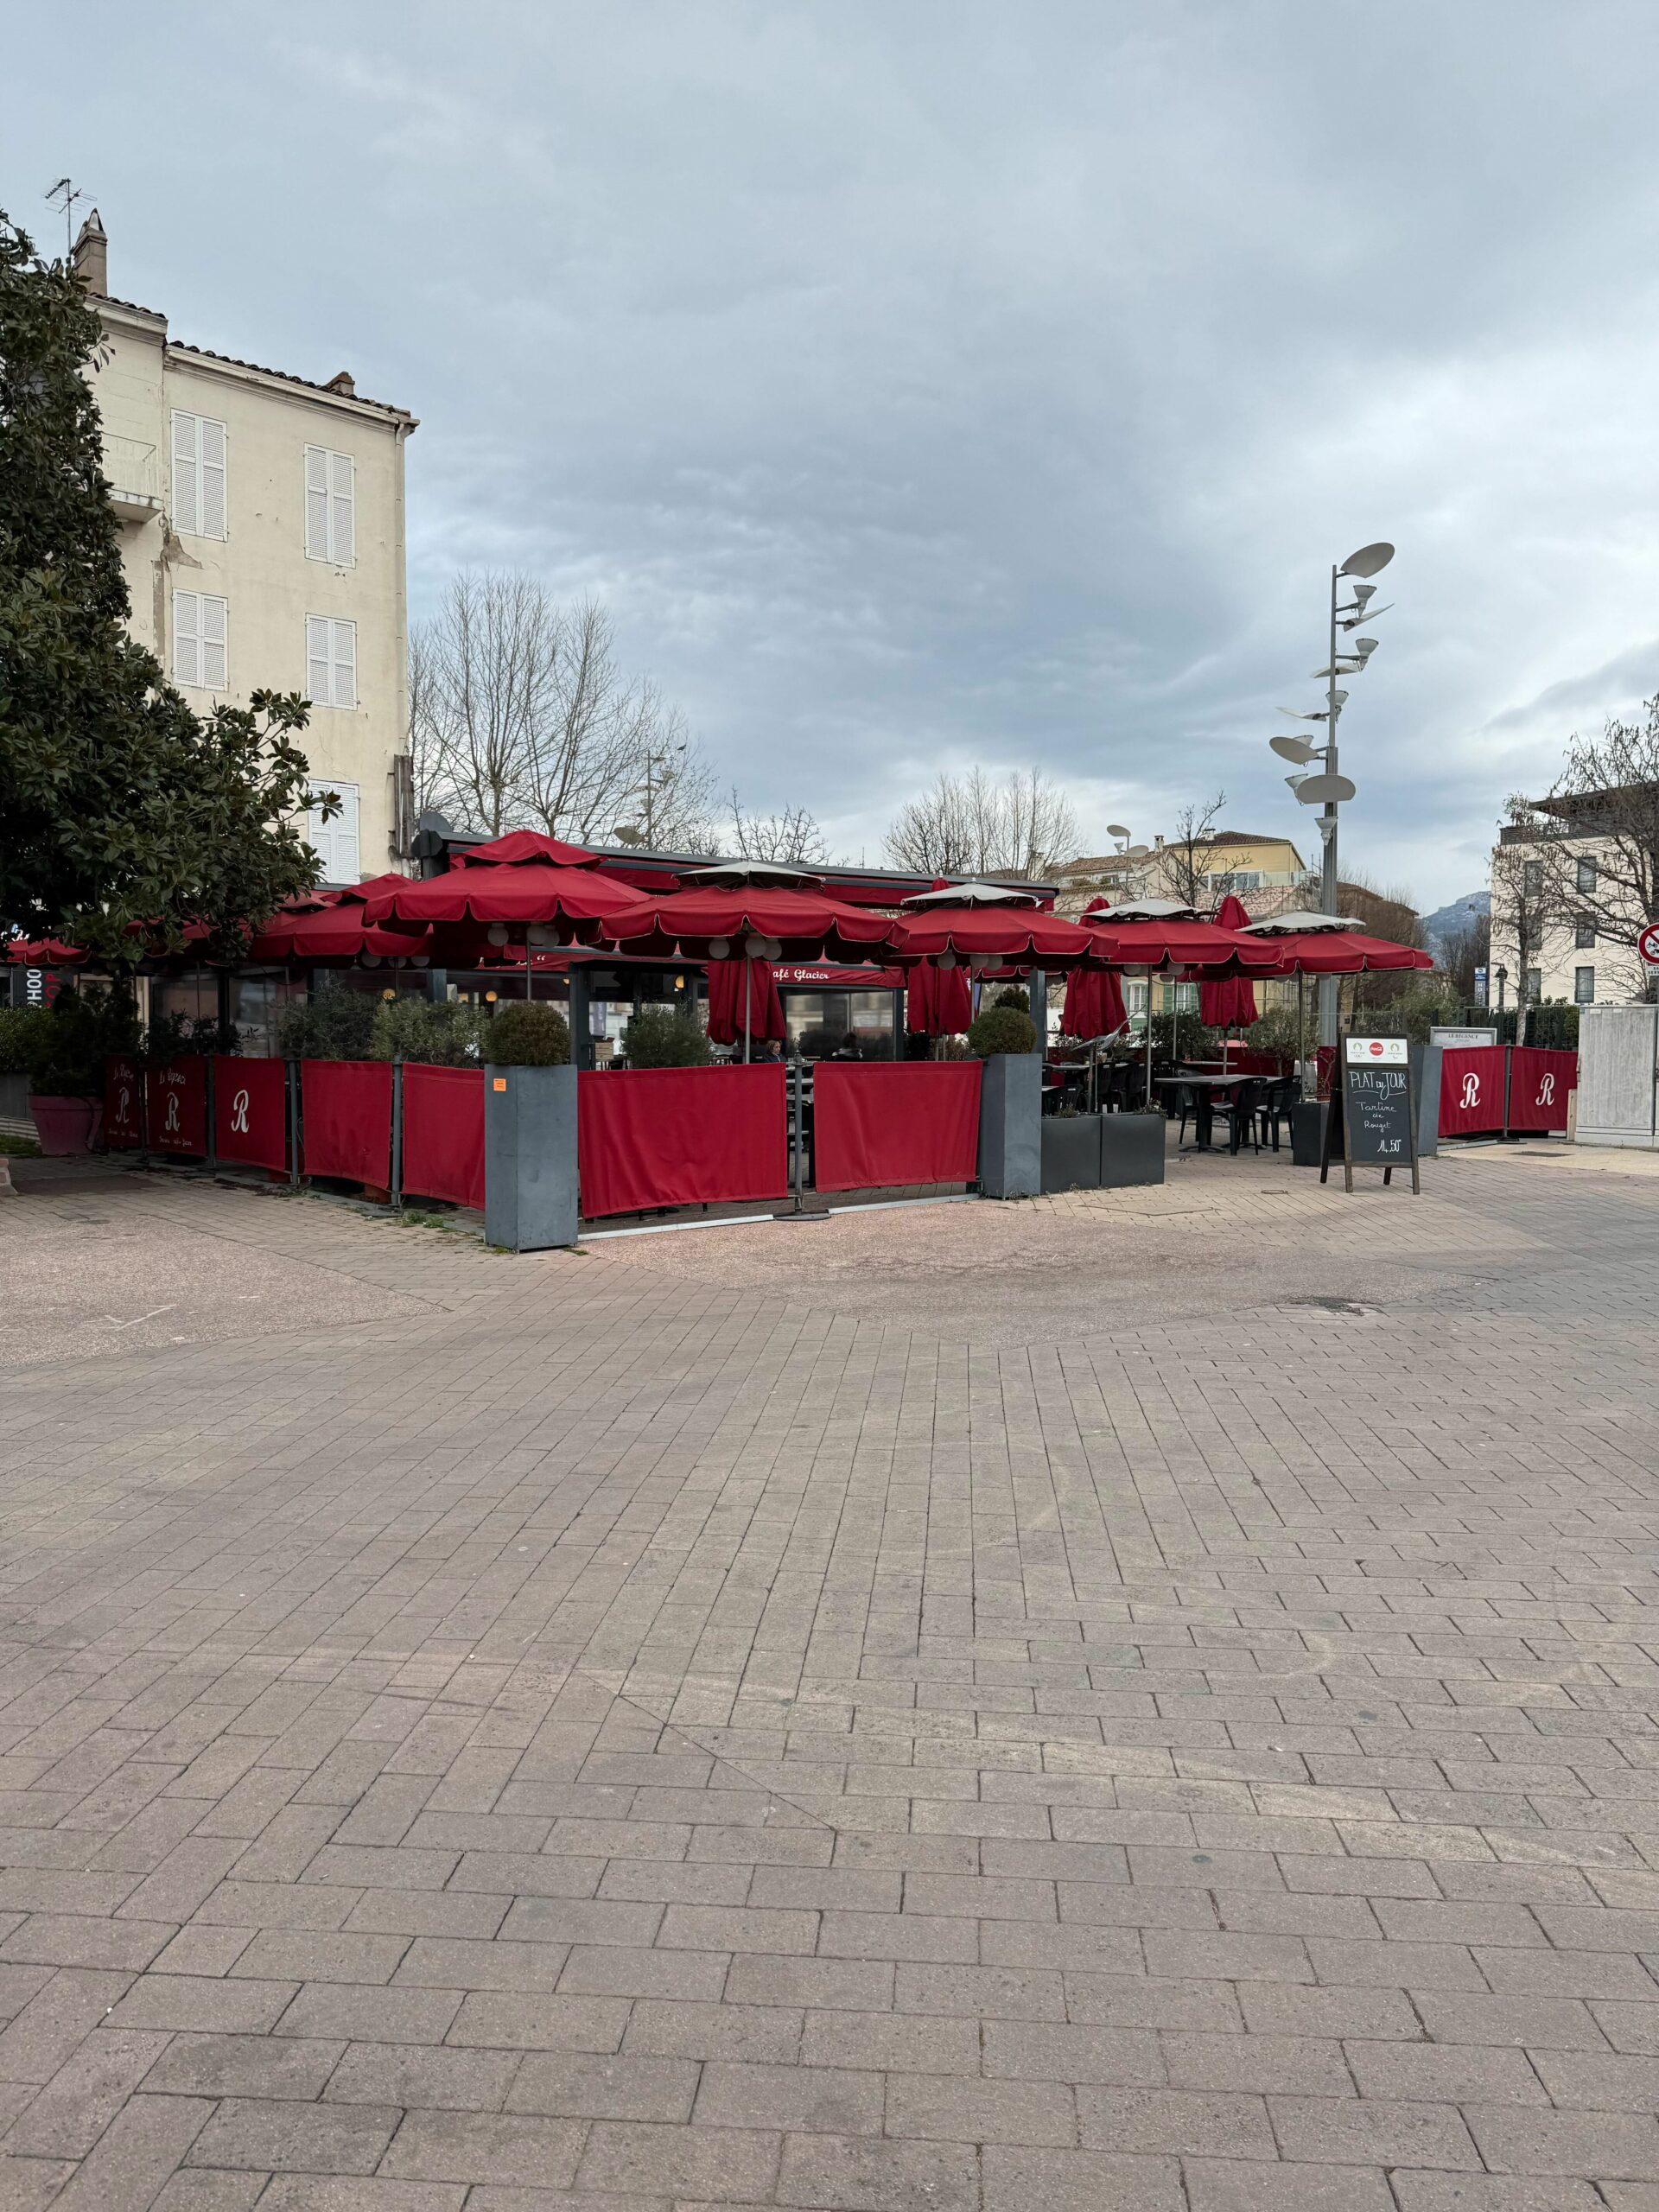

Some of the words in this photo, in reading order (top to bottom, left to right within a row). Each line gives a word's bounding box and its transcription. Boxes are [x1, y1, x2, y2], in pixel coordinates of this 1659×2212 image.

[772, 969, 789, 981] afé
[794, 969, 830, 981] Glacier
[1349, 1071, 1376, 1088] PLAT
[1380, 1072, 1407, 1101] JOUR
[1459, 1072, 1481, 1109] R
[1535, 1072, 1555, 1106] R
[165, 1091, 181, 1132] R
[231, 1090, 249, 1133] R
[1355, 1102, 1397, 1112] Tartine
[1363, 1120, 1392, 1133] Rouget
